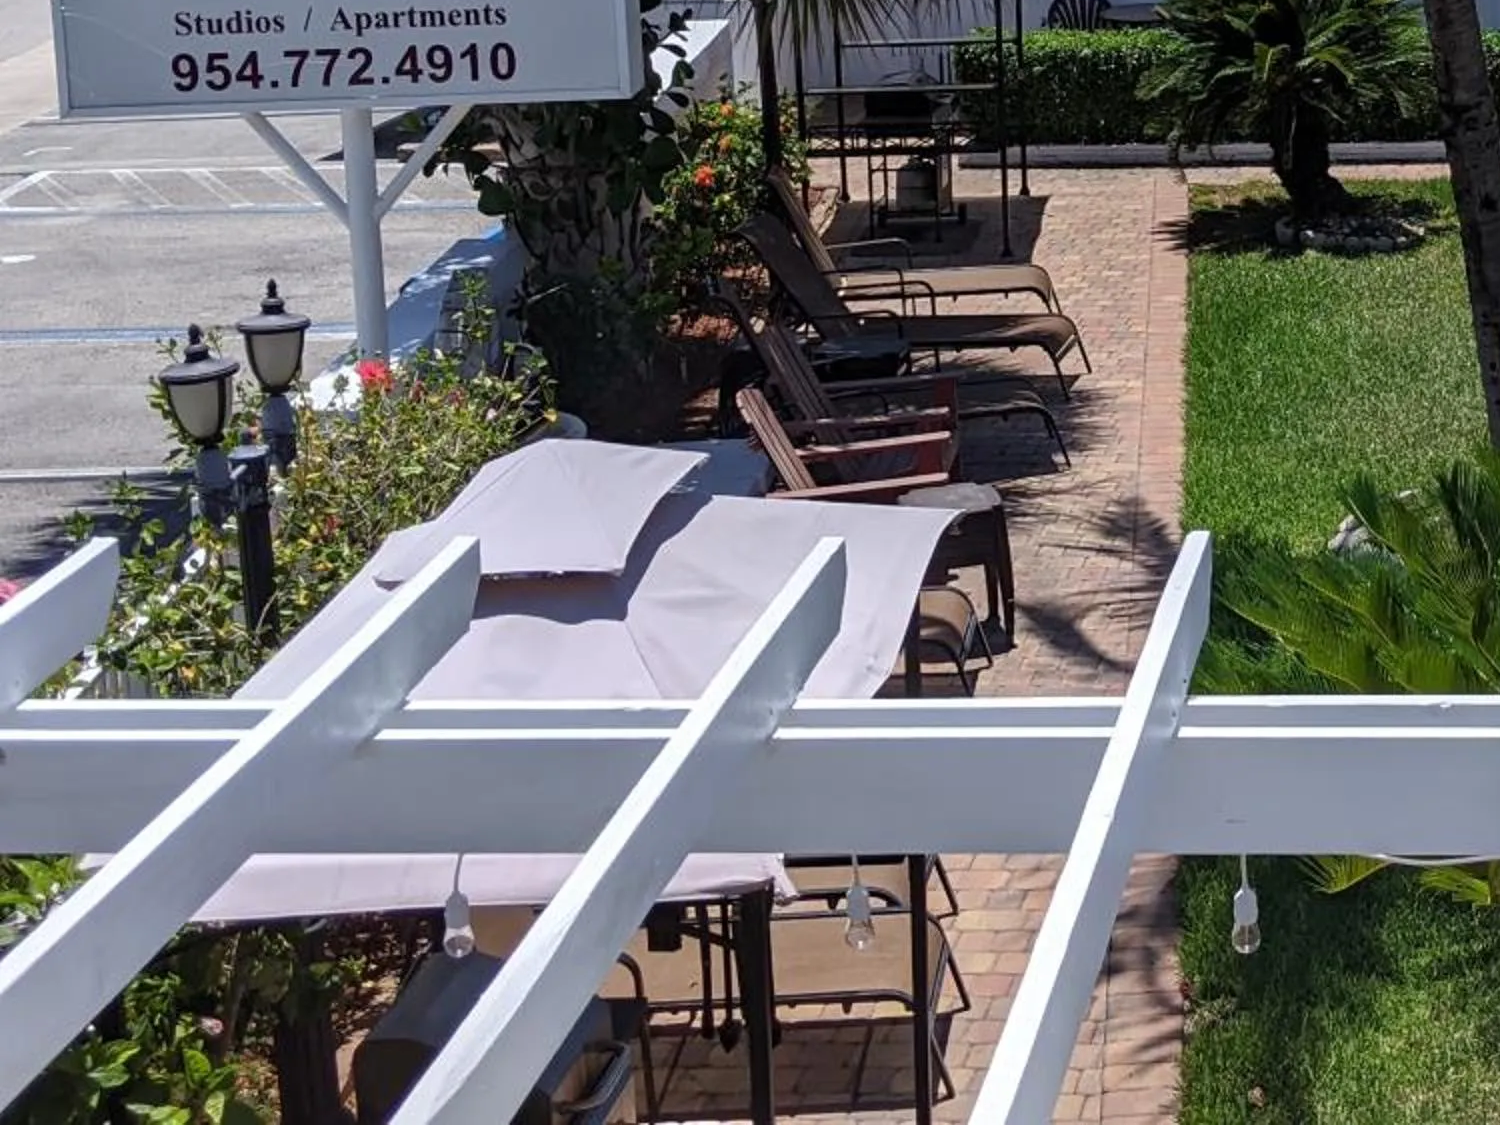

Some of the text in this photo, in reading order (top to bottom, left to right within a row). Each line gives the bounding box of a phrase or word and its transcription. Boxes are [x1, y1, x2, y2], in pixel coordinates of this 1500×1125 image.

[174, 2, 508, 38] Studios / Apartments
[171, 42, 517, 92] 954.772.4910
